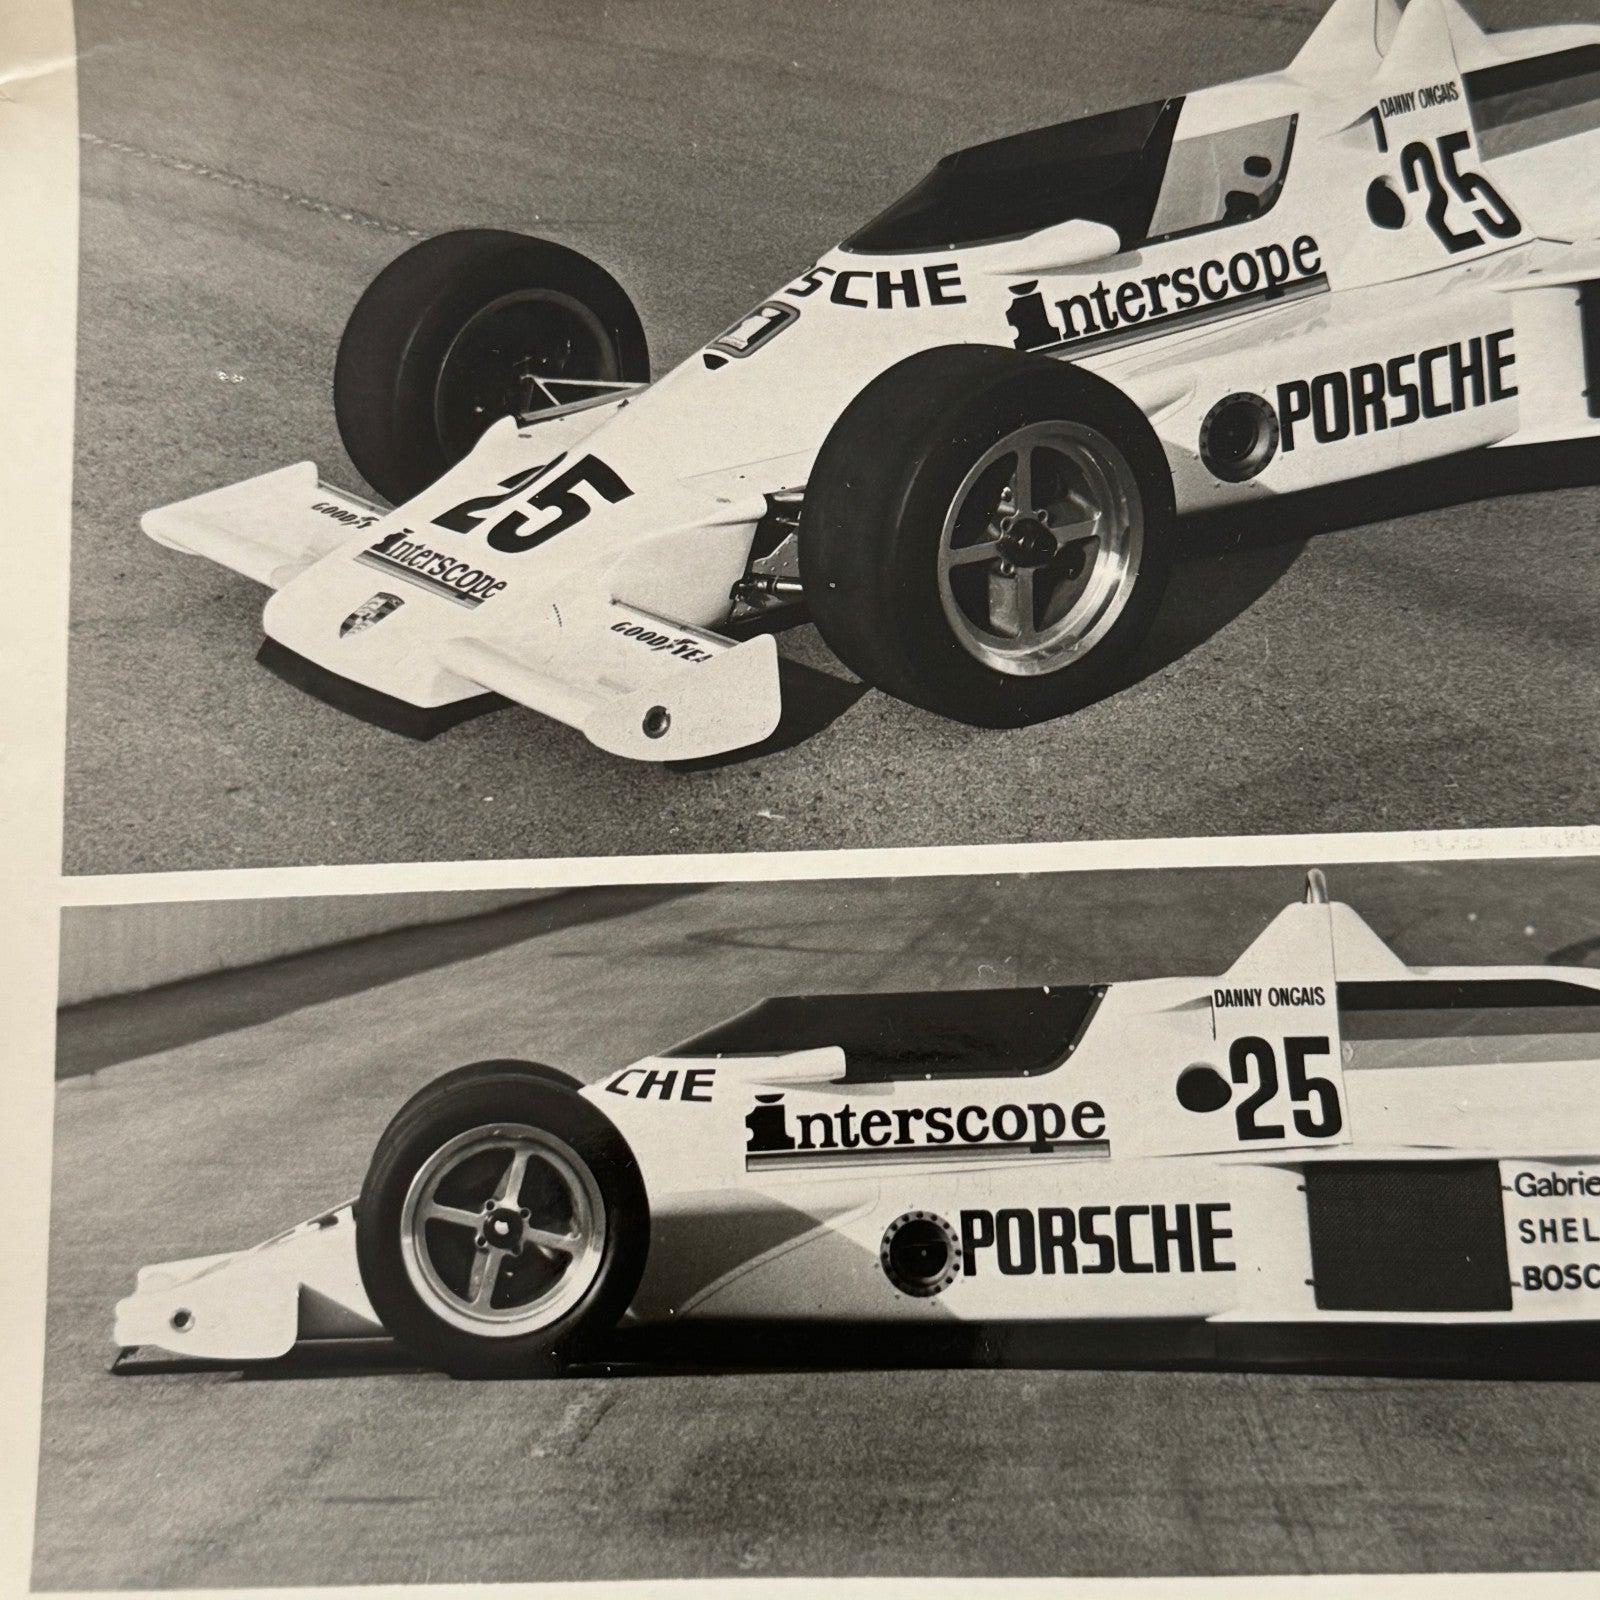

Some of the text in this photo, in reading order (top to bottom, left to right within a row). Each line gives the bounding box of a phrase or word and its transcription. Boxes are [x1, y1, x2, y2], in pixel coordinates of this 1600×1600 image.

[1380, 81, 1459, 118] DANNY ONGAIS
[1400, 130, 1521, 254] 25
[1006, 235, 1321, 349] interscope
[1277, 328, 1519, 453] PORSCHE
[430, 453, 634, 553] 25
[370, 528, 507, 602] interscope
[1214, 986, 1326, 1008] DANNY ONGAIS
[605, 1069, 716, 1102] CHE
[1229, 1035, 1343, 1141] 25
[745, 1093, 1107, 1153] interscope
[1514, 1170, 1600, 1198] Gabrie
[959, 1202, 1236, 1277] PORSCHE
[1518, 1217, 1600, 1244] SHEL
[1522, 1263, 1600, 1291] BOSC
